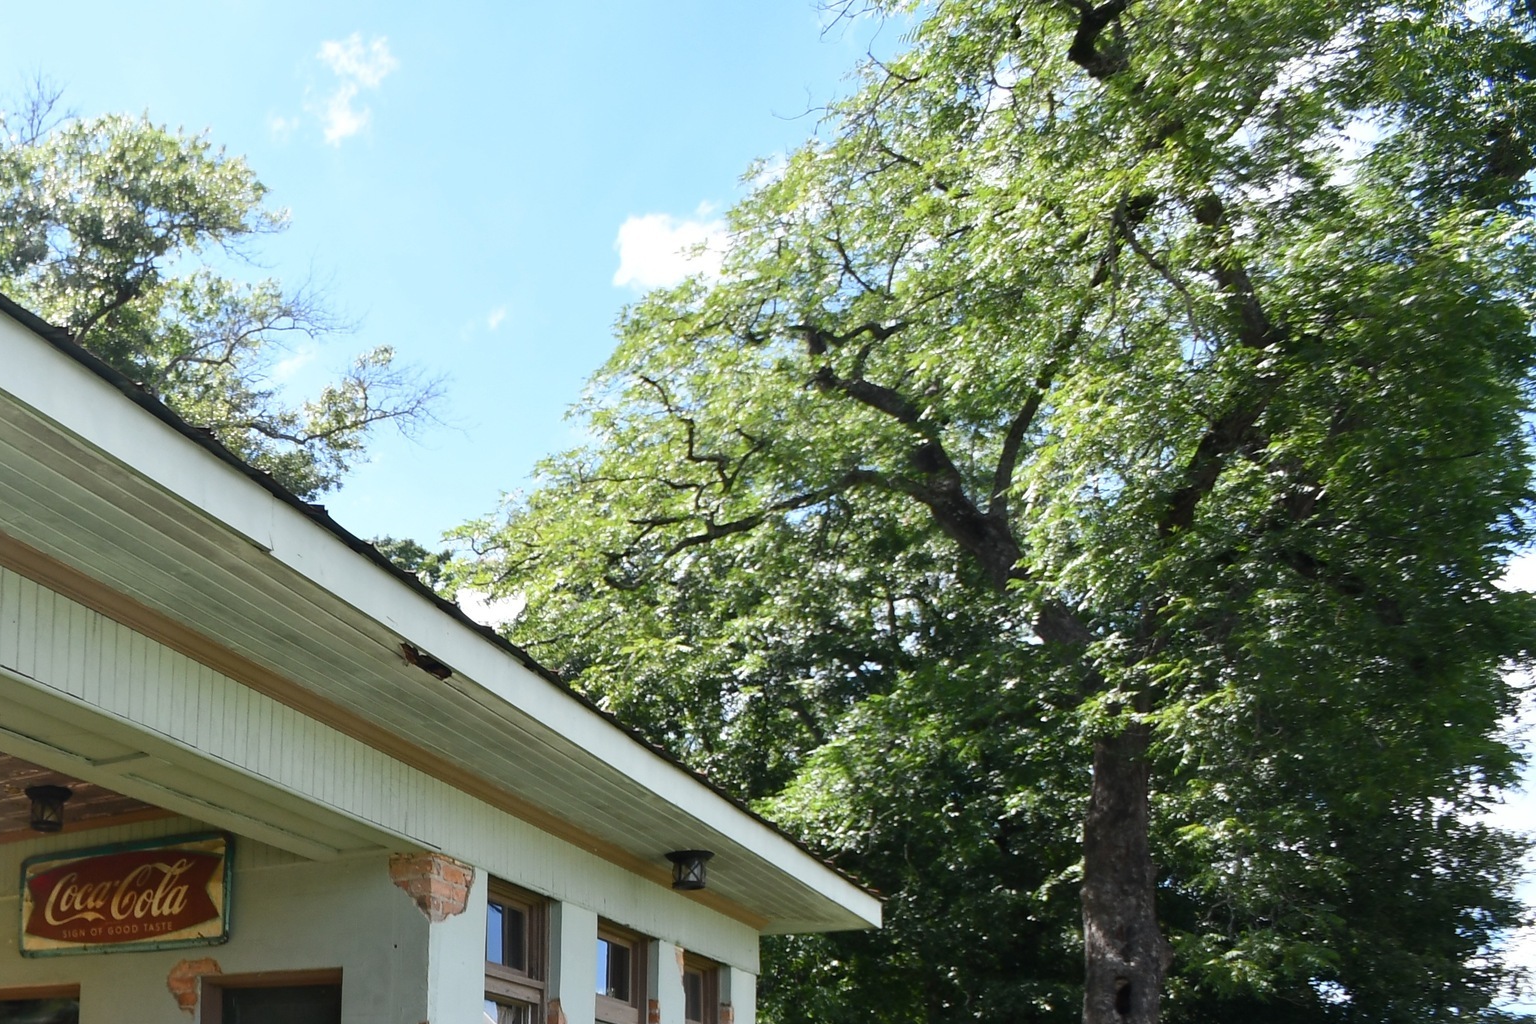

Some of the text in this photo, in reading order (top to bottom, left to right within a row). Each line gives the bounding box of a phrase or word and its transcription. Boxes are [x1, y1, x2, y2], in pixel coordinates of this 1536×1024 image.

[44, 858, 196, 926] Coca-Cola
[62, 920, 173, 939] SIGN OF GOOD TASTE
